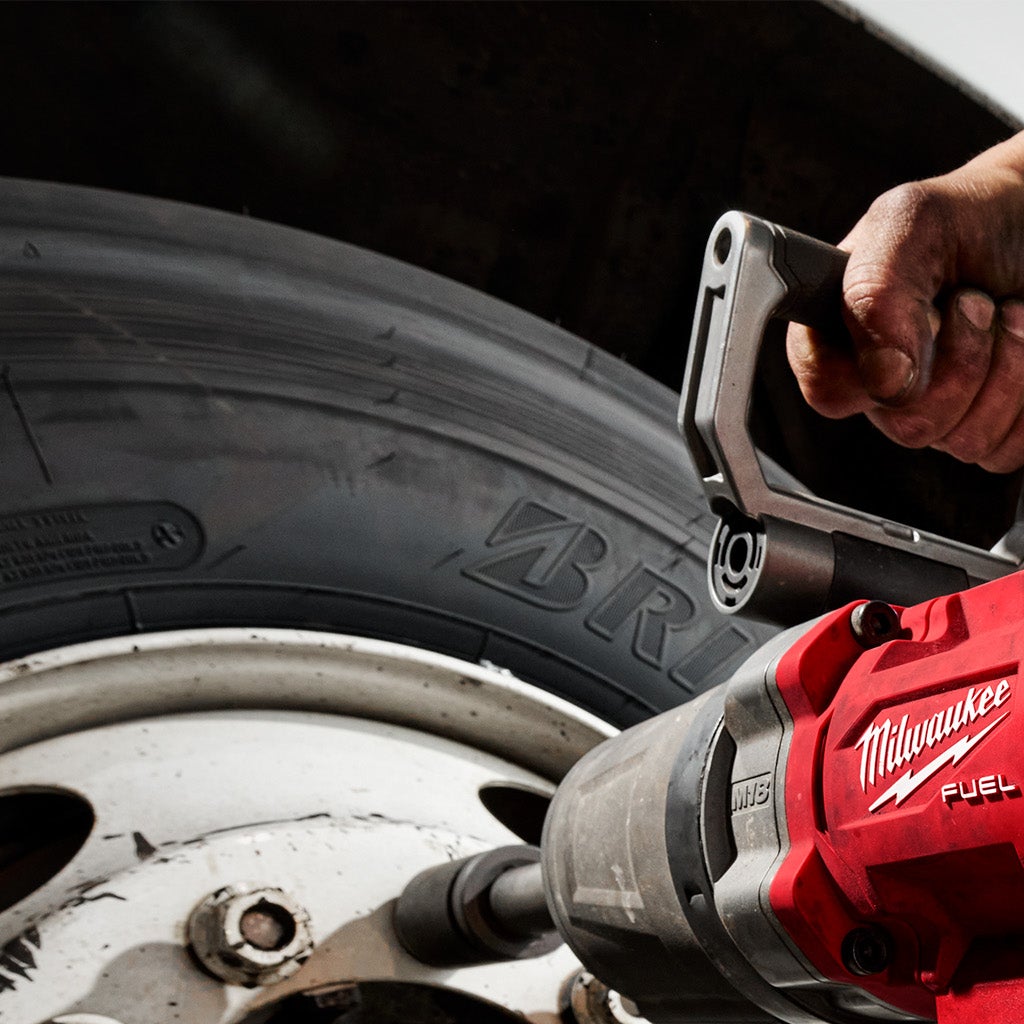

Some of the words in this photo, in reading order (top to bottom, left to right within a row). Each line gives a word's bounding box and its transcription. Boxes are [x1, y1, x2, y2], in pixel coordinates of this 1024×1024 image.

[854, 679, 1012, 795] Milwaukee
[732, 778, 770, 812] M18
[942, 774, 1018, 803] FUEL
